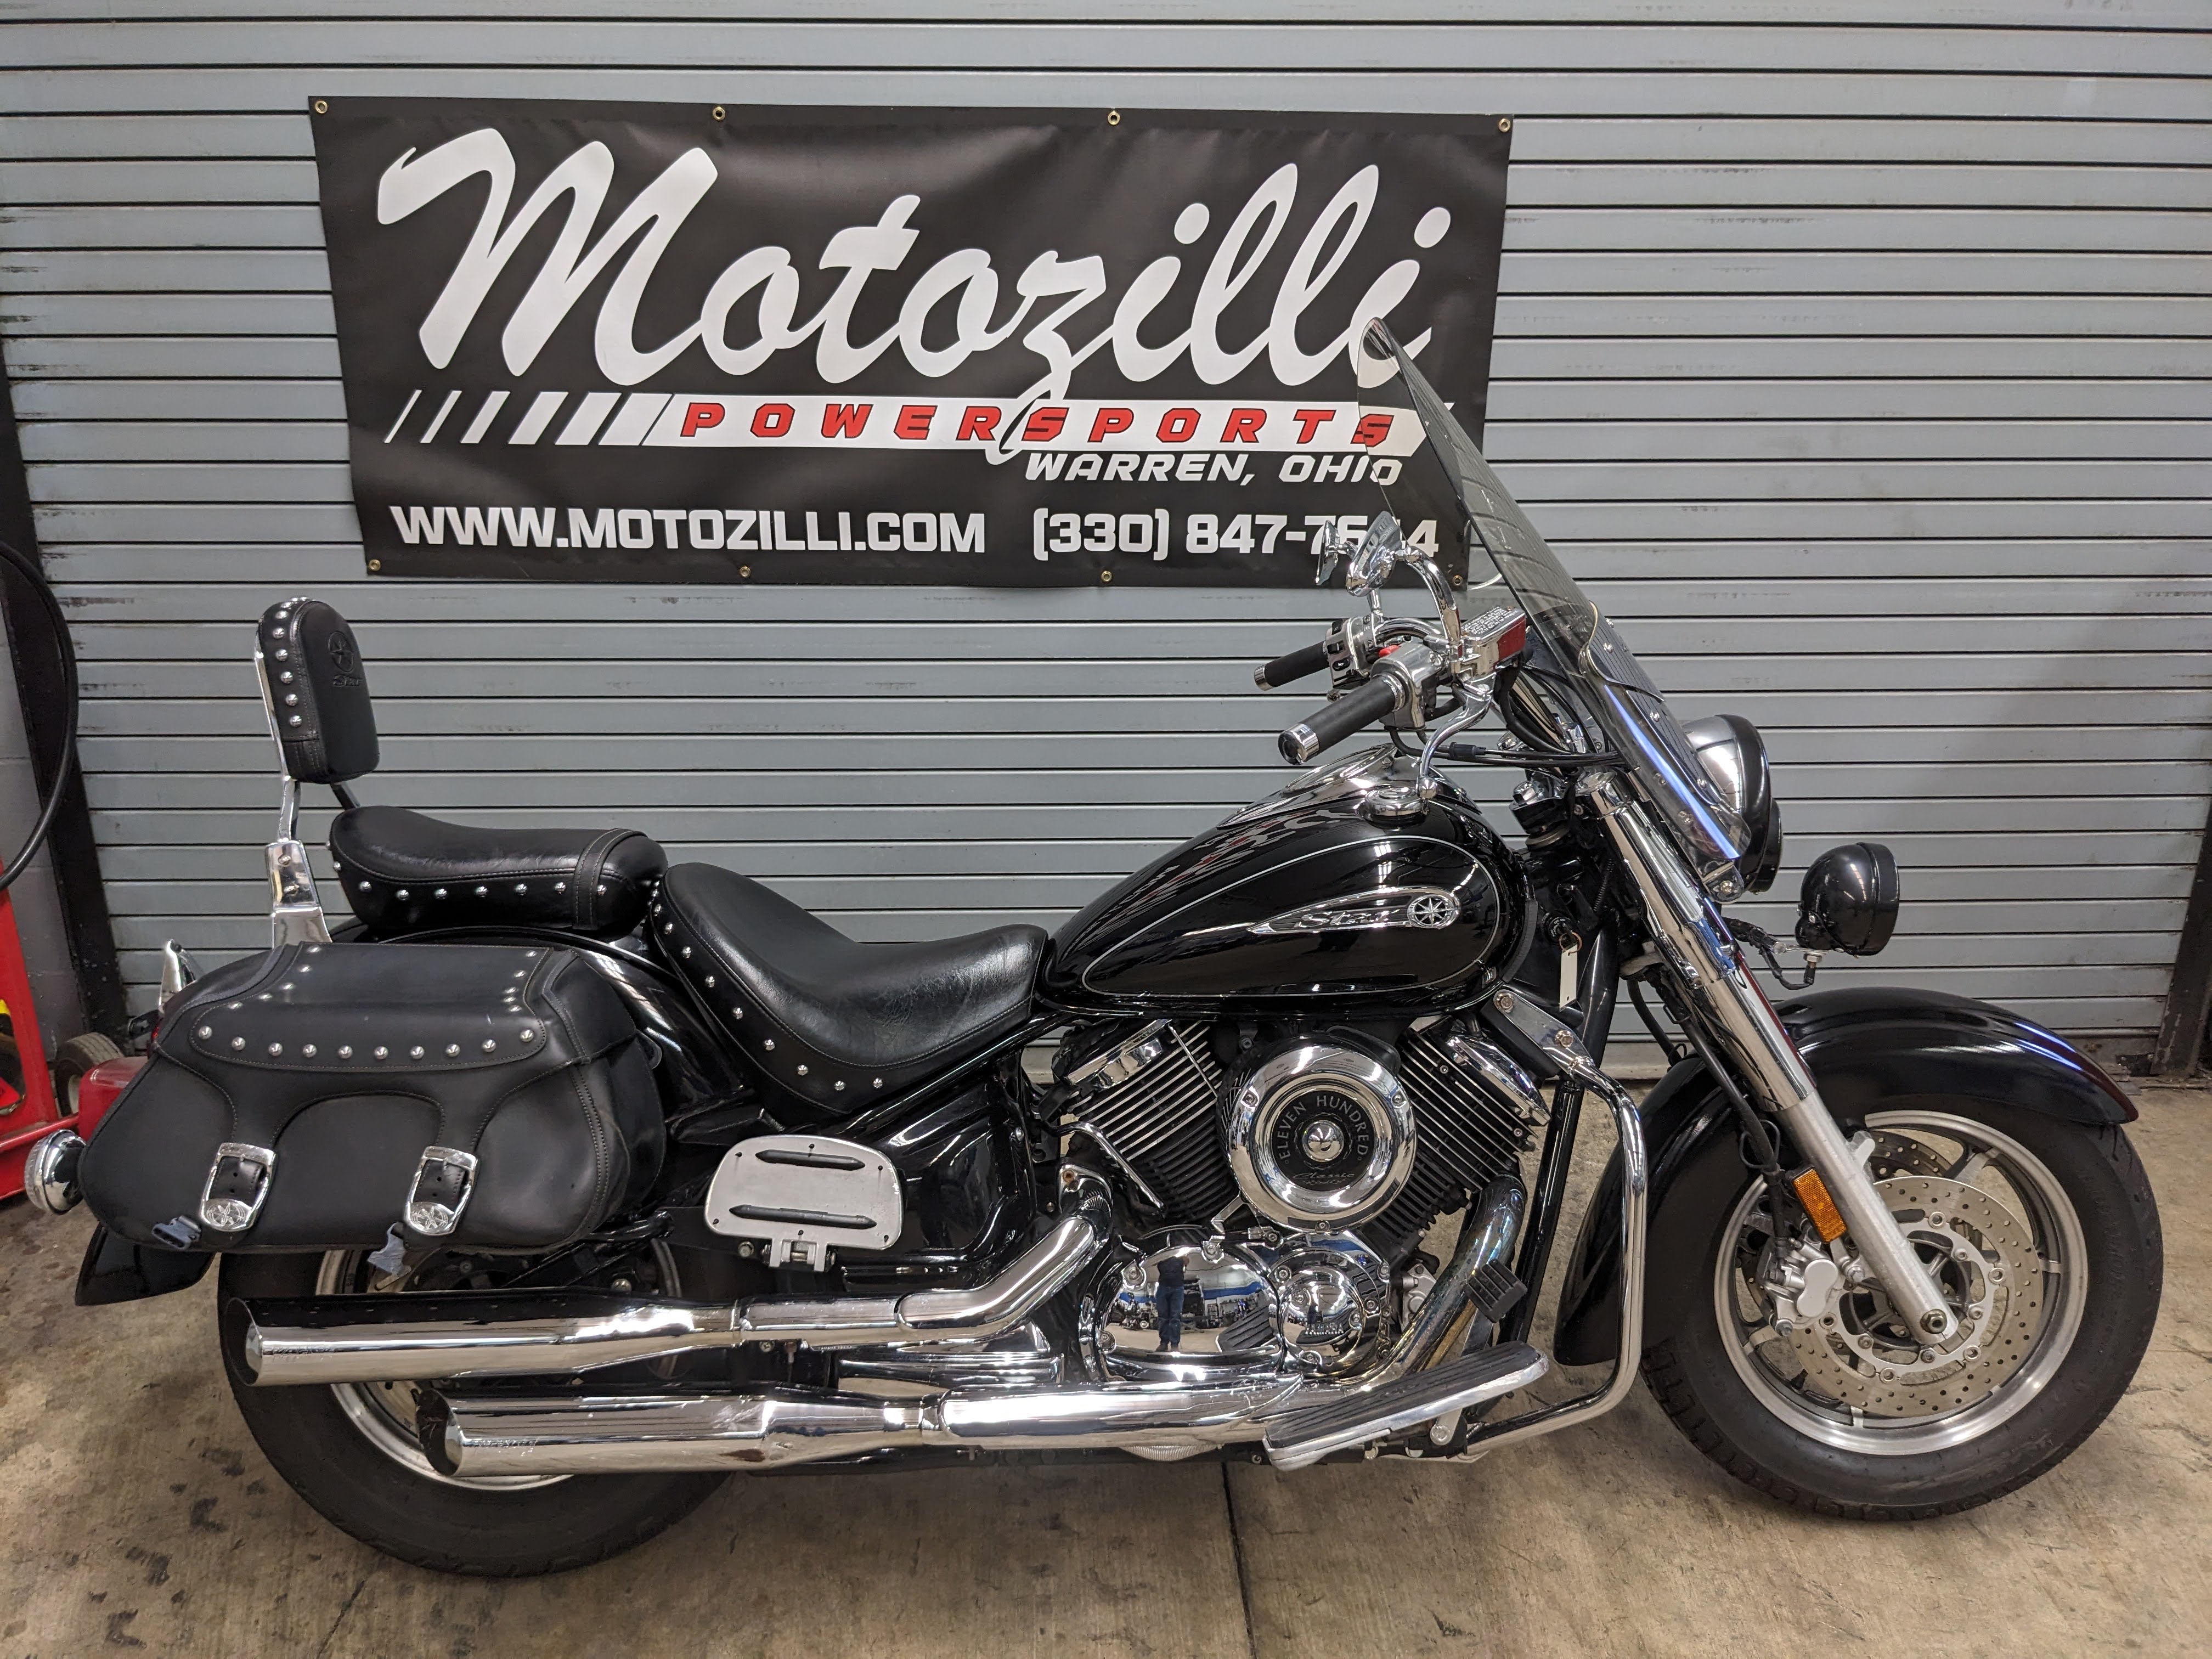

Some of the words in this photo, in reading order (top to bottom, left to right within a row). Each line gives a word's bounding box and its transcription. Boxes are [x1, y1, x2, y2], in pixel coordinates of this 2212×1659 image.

[377, 128, 1451, 465] Motozilli
[680, 402, 1395, 448] POWERSPORTS
[1025, 453, 1257, 486] WARREN,
[1278, 455, 1403, 486] OHIO
[389, 506, 985, 552] WWW.MOTOZILLI.COM
[1033, 508, 1170, 561] (330)
[1186, 514, 1440, 558] 847-764
[1277, 1101, 1307, 1160] ELEVEN
[1317, 1095, 1370, 1156] HUNDRED
